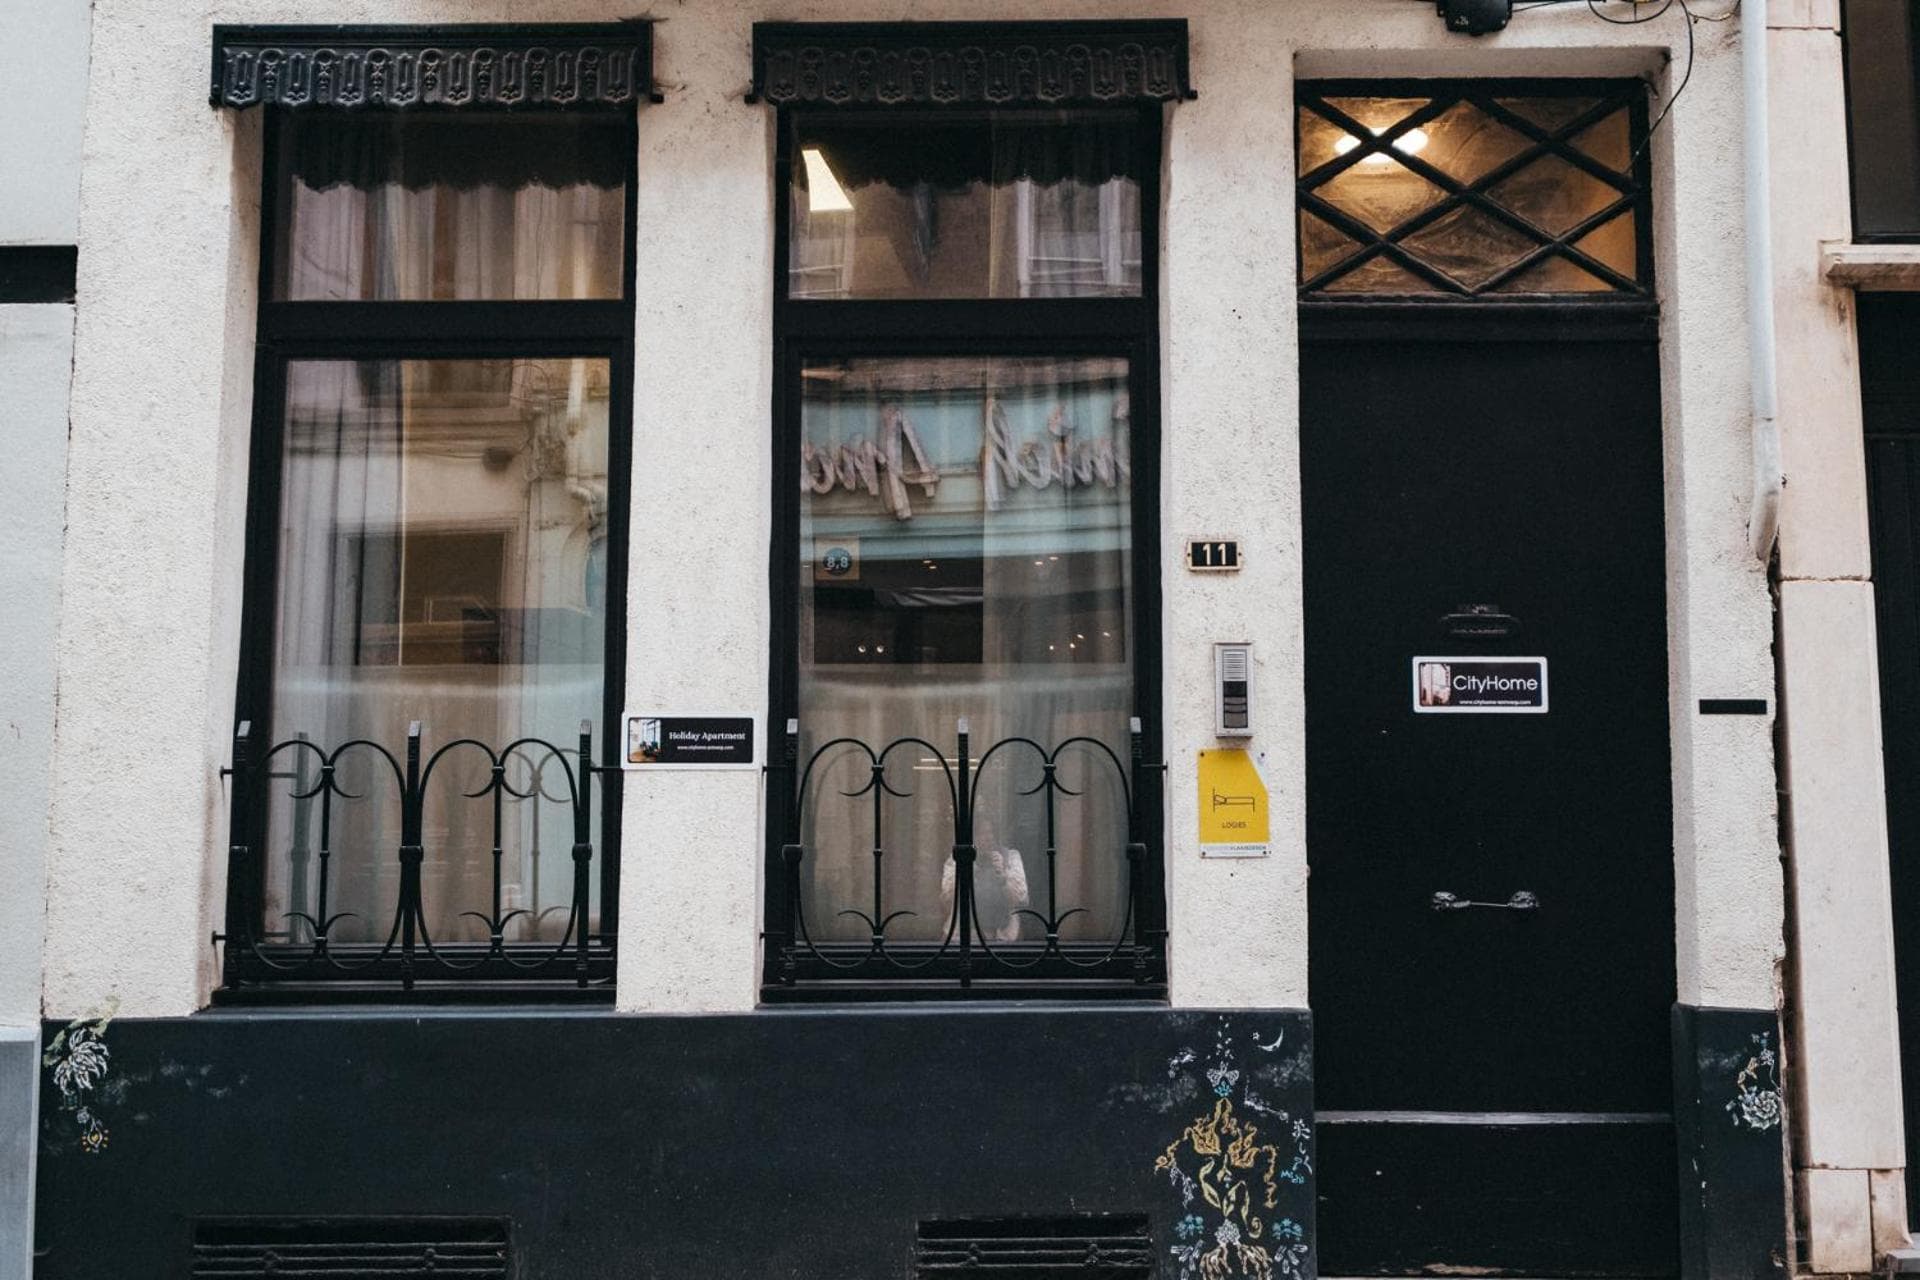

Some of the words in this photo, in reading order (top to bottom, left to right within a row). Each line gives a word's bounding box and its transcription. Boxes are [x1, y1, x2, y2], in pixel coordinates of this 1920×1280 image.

[1202, 543, 1226, 565] 11
[1453, 675, 1538, 694] CityHome
[668, 731, 700, 742] Holiday
[701, 731, 746, 742] Apartment
